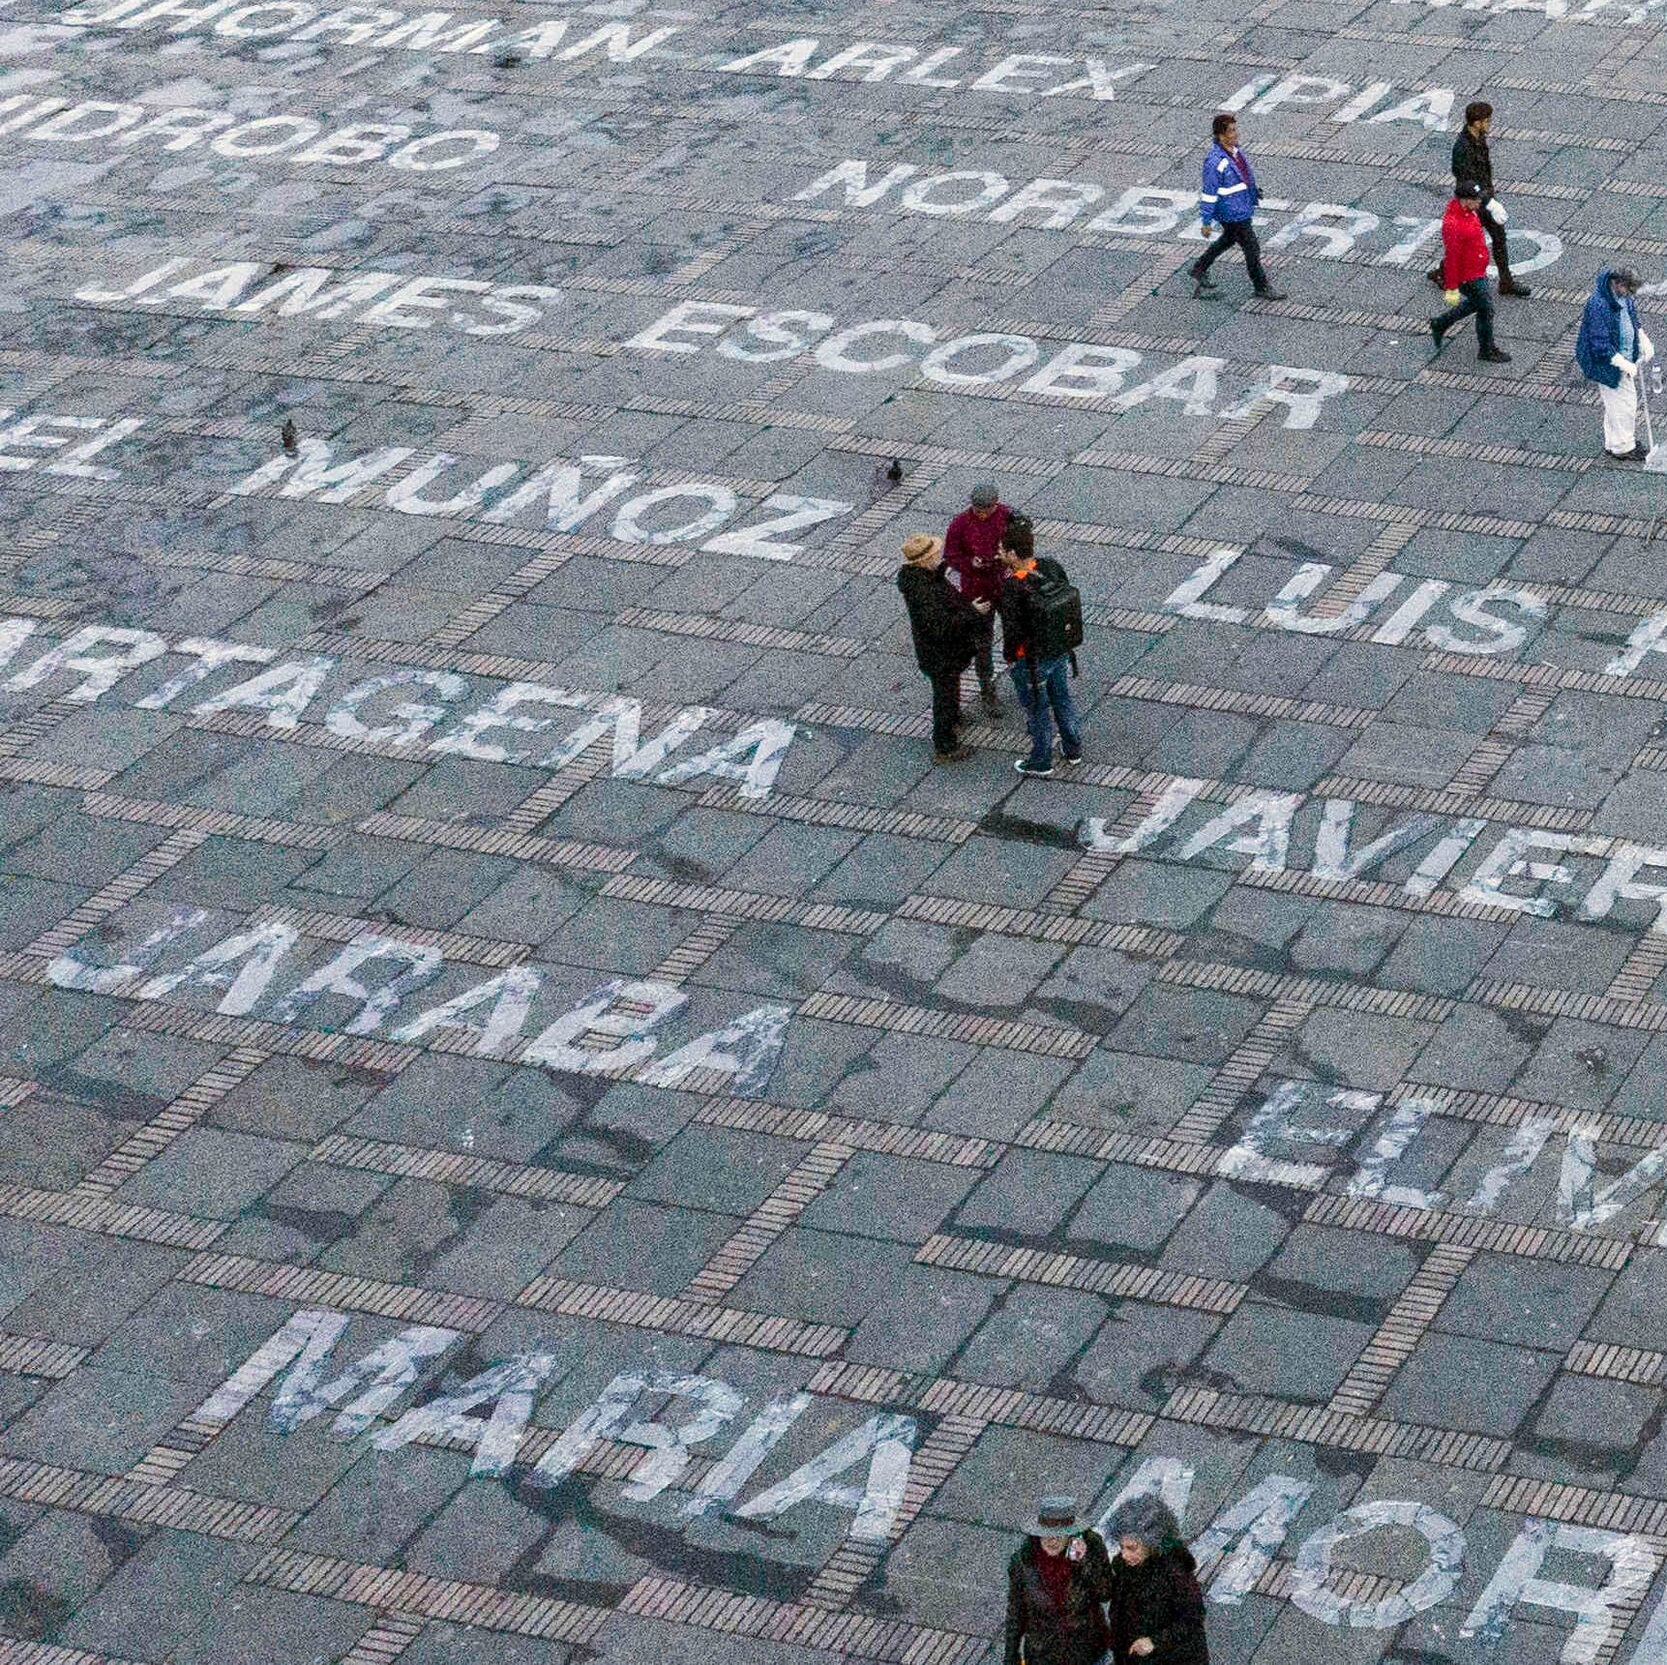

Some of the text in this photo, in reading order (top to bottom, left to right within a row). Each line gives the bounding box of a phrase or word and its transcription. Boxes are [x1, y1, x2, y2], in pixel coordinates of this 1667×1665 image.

[722, 37, 1160, 102] ARLEX
[74, 256, 1352, 431] JAMES ESCOBAR
[228, 437, 856, 564] MUÑOZ
[1162, 542, 1553, 656] LUIS
